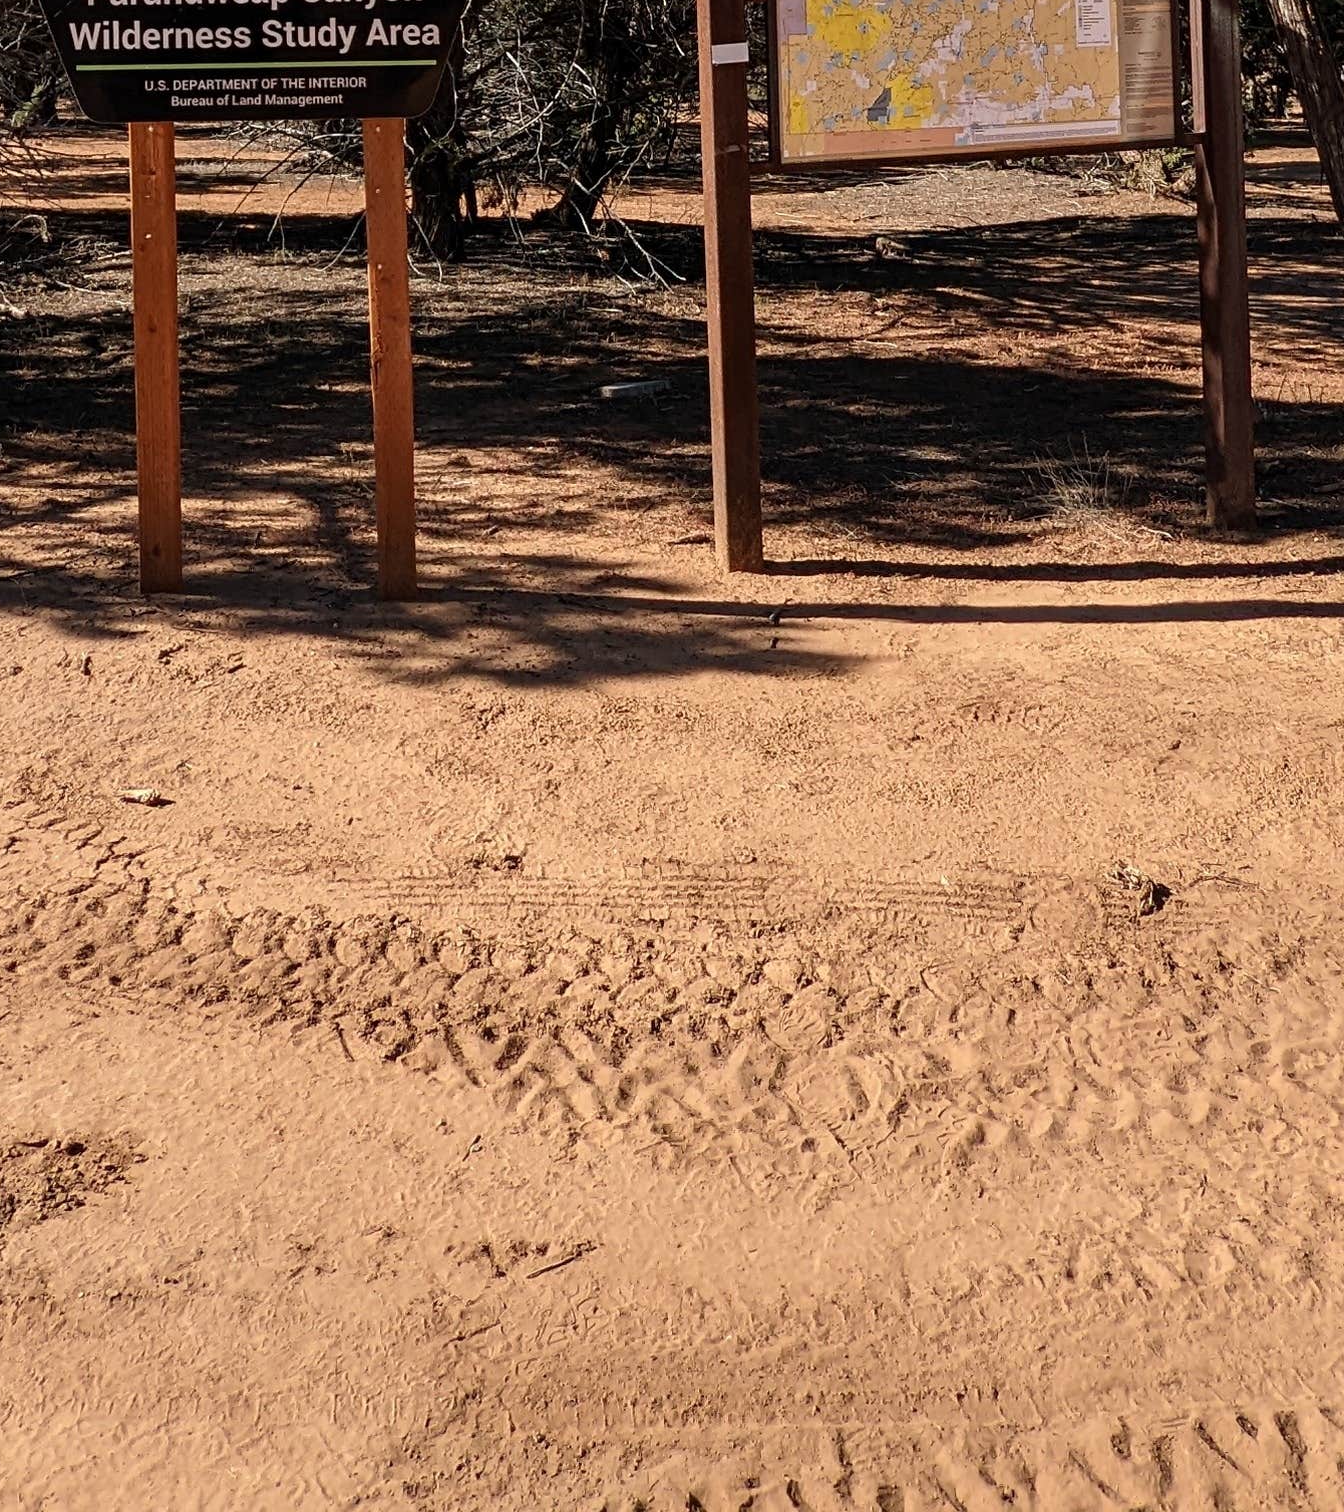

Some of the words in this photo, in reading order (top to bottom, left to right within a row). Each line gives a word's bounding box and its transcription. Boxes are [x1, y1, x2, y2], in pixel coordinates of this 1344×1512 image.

[69, 19, 252, 51] Wilderness
[261, 17, 357, 55] Study
[365, 18, 441, 46] Area
[144, 80, 169, 92] U.S.
[173, 78, 259, 91] DEPARTMENT
[261, 78, 278, 90] OF
[280, 78, 306, 89] THE
[308, 76, 367, 89] INTERIOR
[171, 95, 214, 107] Bureau
[216, 94, 230, 106] of
[232, 94, 262, 106] Land
[264, 93, 344, 107] Management
